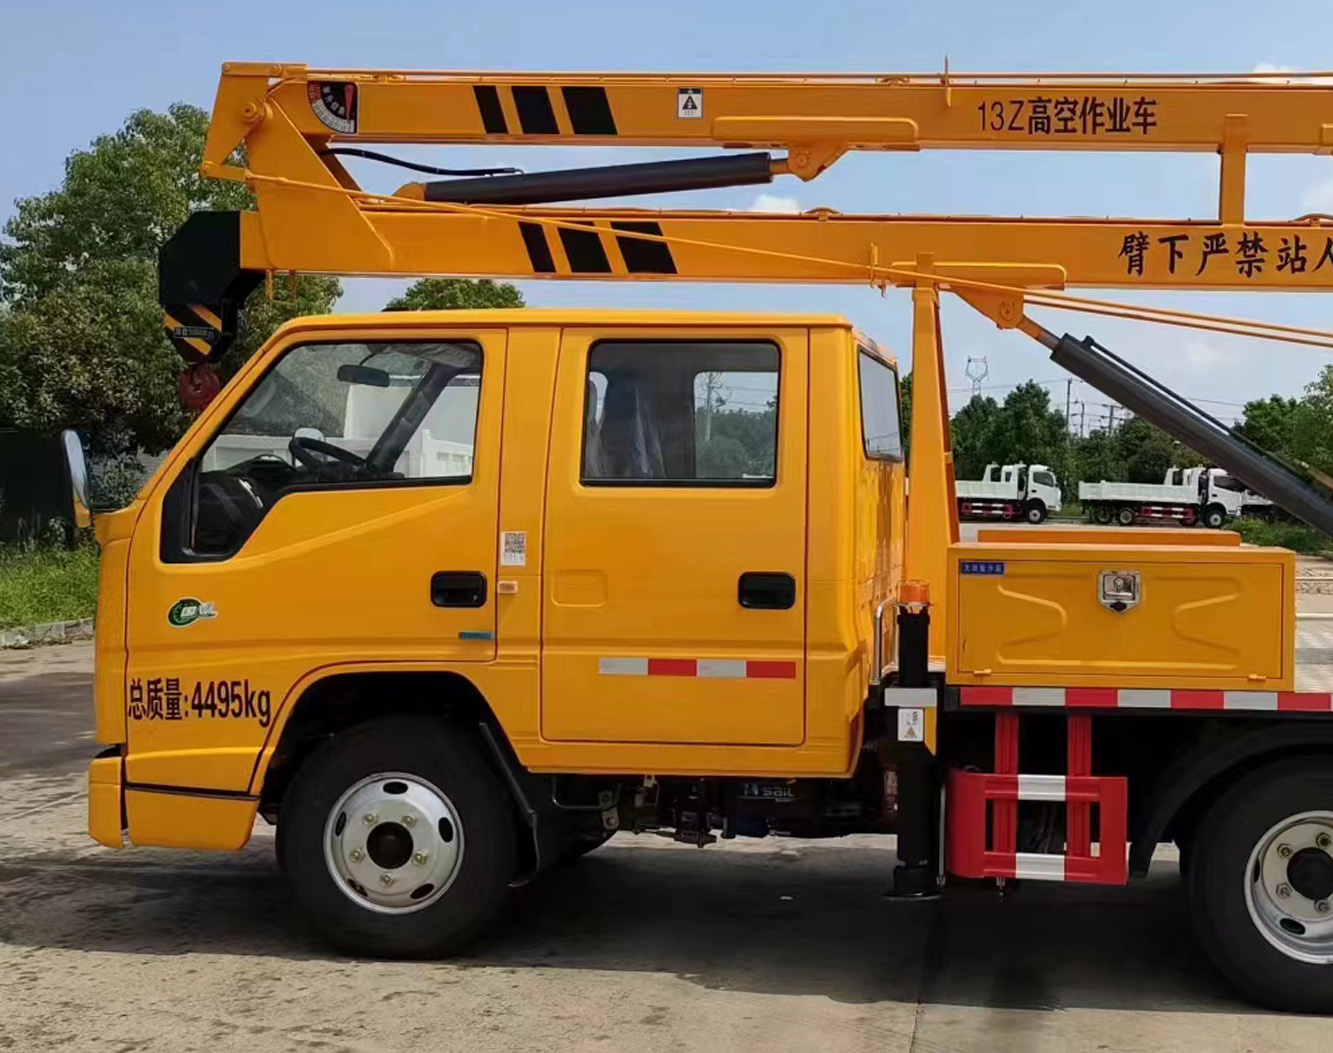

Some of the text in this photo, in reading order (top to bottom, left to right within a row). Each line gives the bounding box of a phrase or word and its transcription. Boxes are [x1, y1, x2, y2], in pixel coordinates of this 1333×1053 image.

[977, 96, 1157, 135] 13Z高空作业车
[128, 677, 271, 728] 总质量:4495kg
